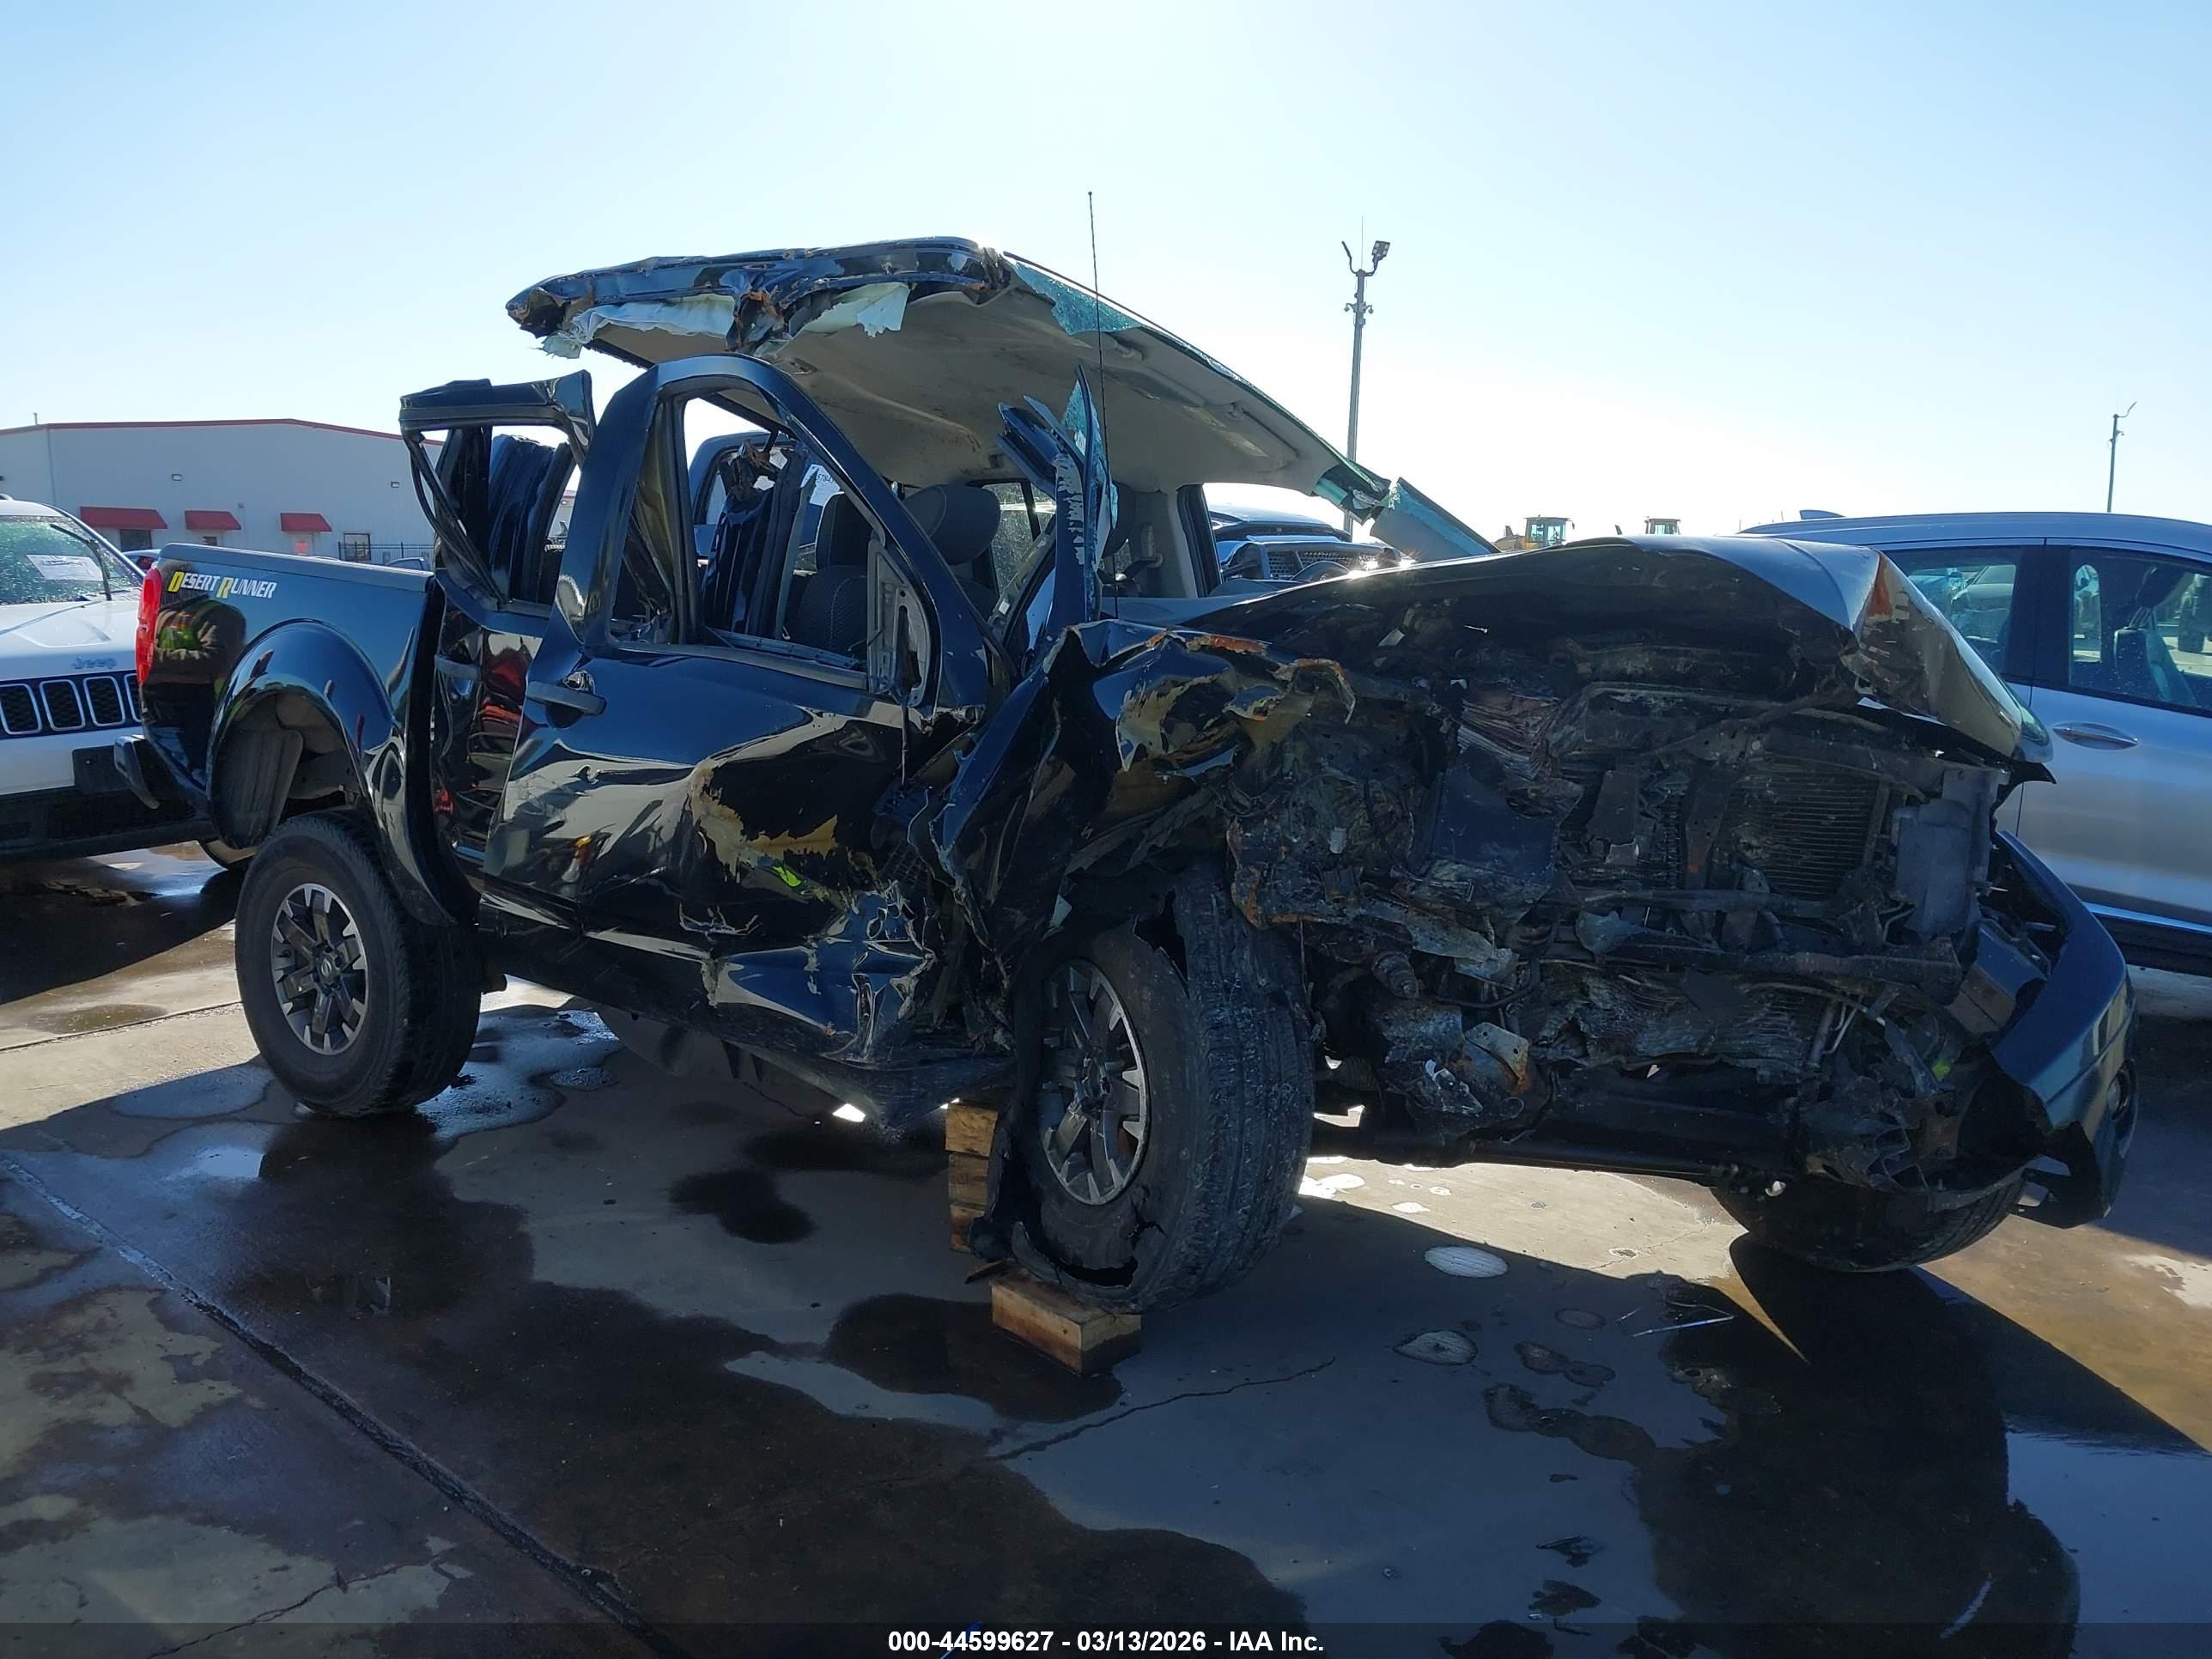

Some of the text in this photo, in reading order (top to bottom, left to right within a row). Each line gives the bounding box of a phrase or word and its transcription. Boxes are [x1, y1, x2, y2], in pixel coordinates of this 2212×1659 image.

[167, 570, 277, 599] DESERT RUNNER
[70, 655, 118, 670] Jeep
